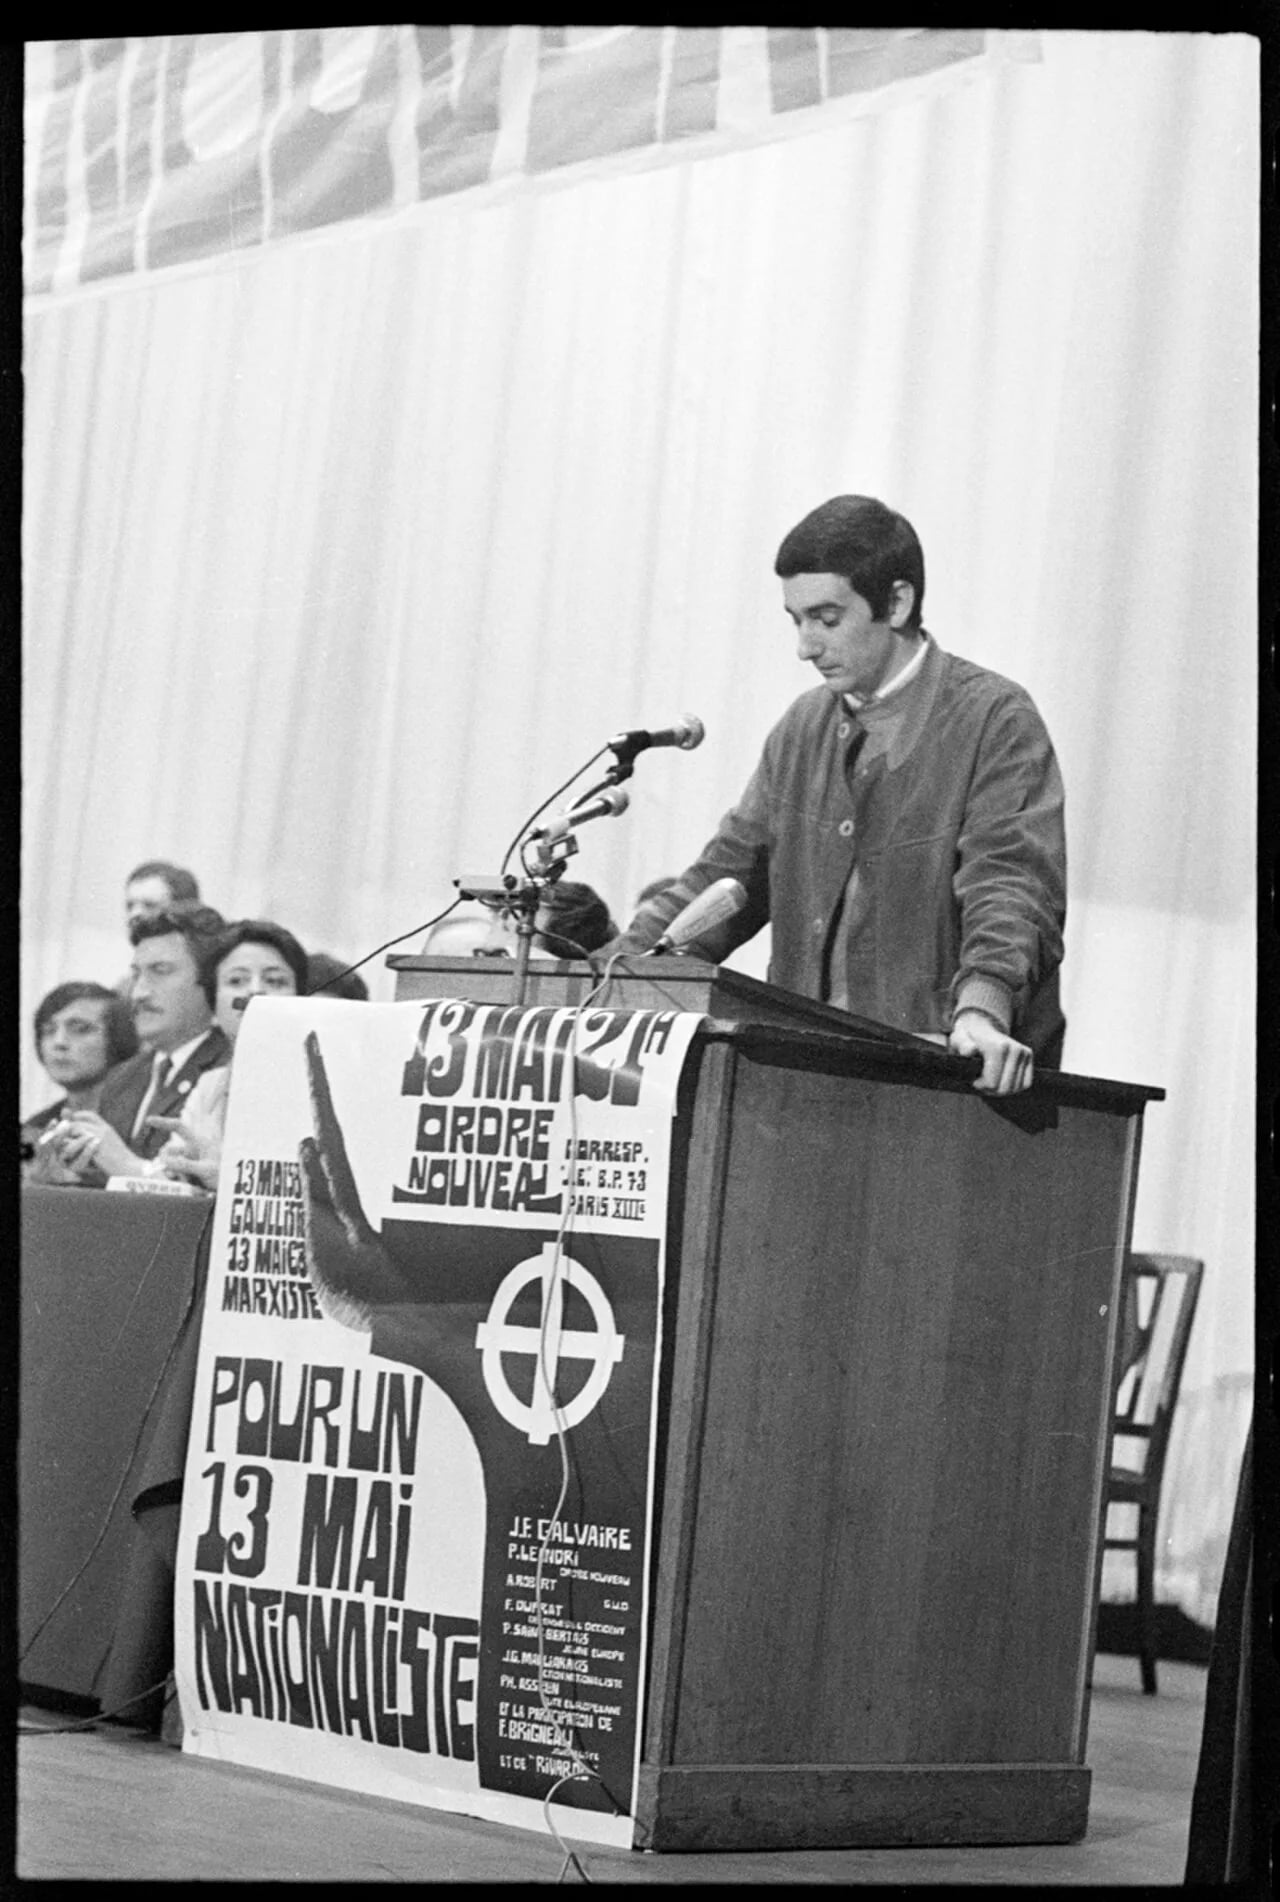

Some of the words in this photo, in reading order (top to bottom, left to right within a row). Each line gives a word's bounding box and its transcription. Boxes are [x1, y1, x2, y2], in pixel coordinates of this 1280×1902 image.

[401, 1001, 478, 1097] 13
[415, 1103, 554, 1161] ORDRE
[234, 1160, 256, 1195] 13
[392, 1156, 562, 1215] NOUVEAU
[228, 1237, 250, 1272] 13
[222, 1275, 323, 1319] MARXiSTE
[194, 1462, 273, 1578] 13
[297, 1473, 414, 1601] MAi
[194, 1579, 480, 1762] NATiONALiSTE
